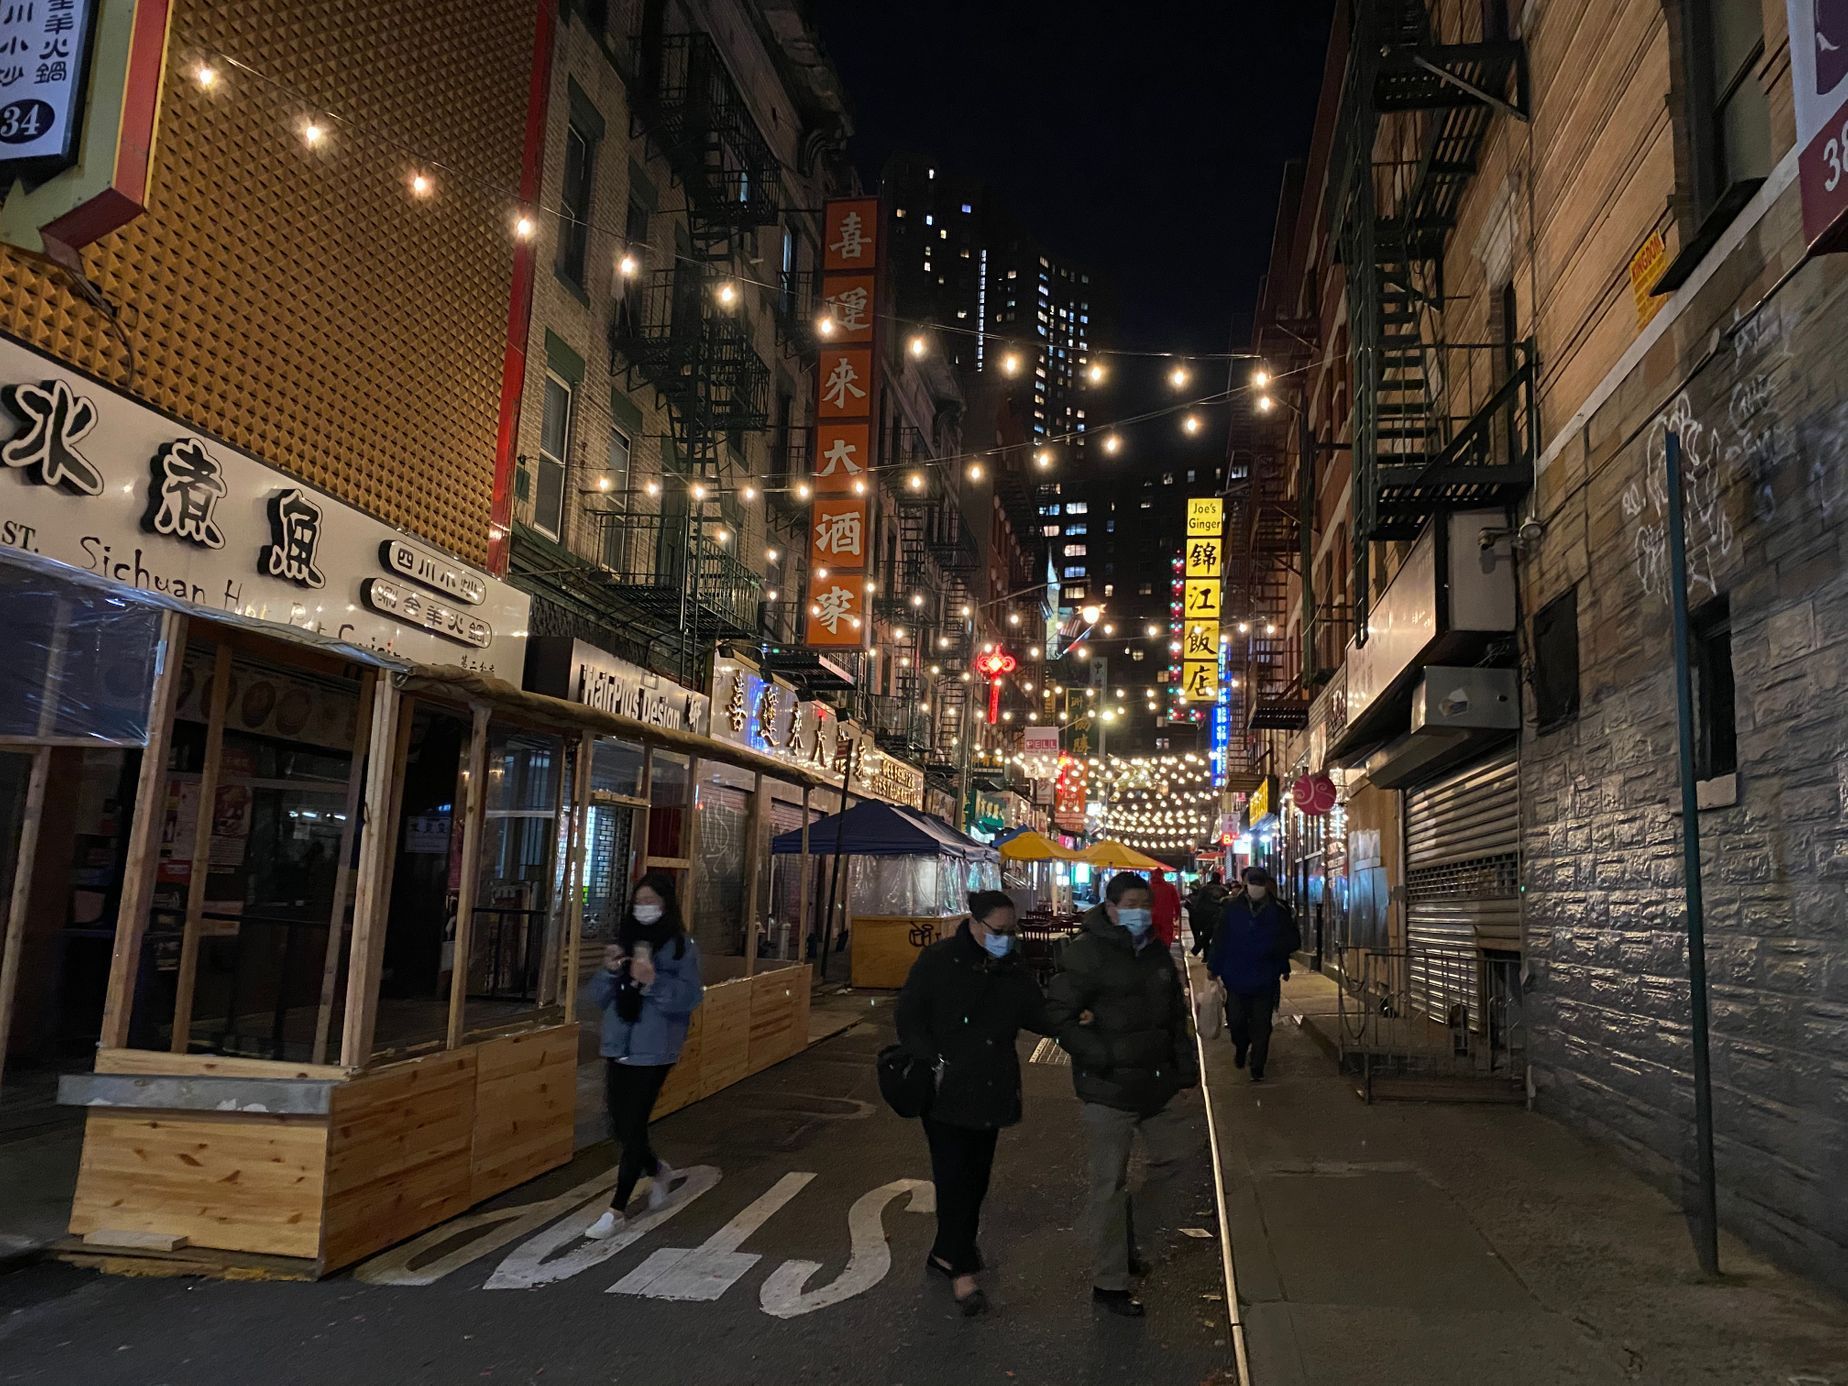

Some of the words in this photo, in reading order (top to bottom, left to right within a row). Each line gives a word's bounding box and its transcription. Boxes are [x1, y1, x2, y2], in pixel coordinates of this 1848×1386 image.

[1, 103, 40, 137] 34
[814, 211, 872, 635] 喜運來大酒家
[1, 378, 326, 590] 水煮魚
[1188, 518, 1221, 531] Ginger
[1193, 503, 1216, 514] Joe's
[1, 520, 39, 553] ST.
[80, 536, 207, 604] Sichuan
[1186, 541, 1218, 697] 錦江飯店
[1026, 740, 1057, 749] PELL
